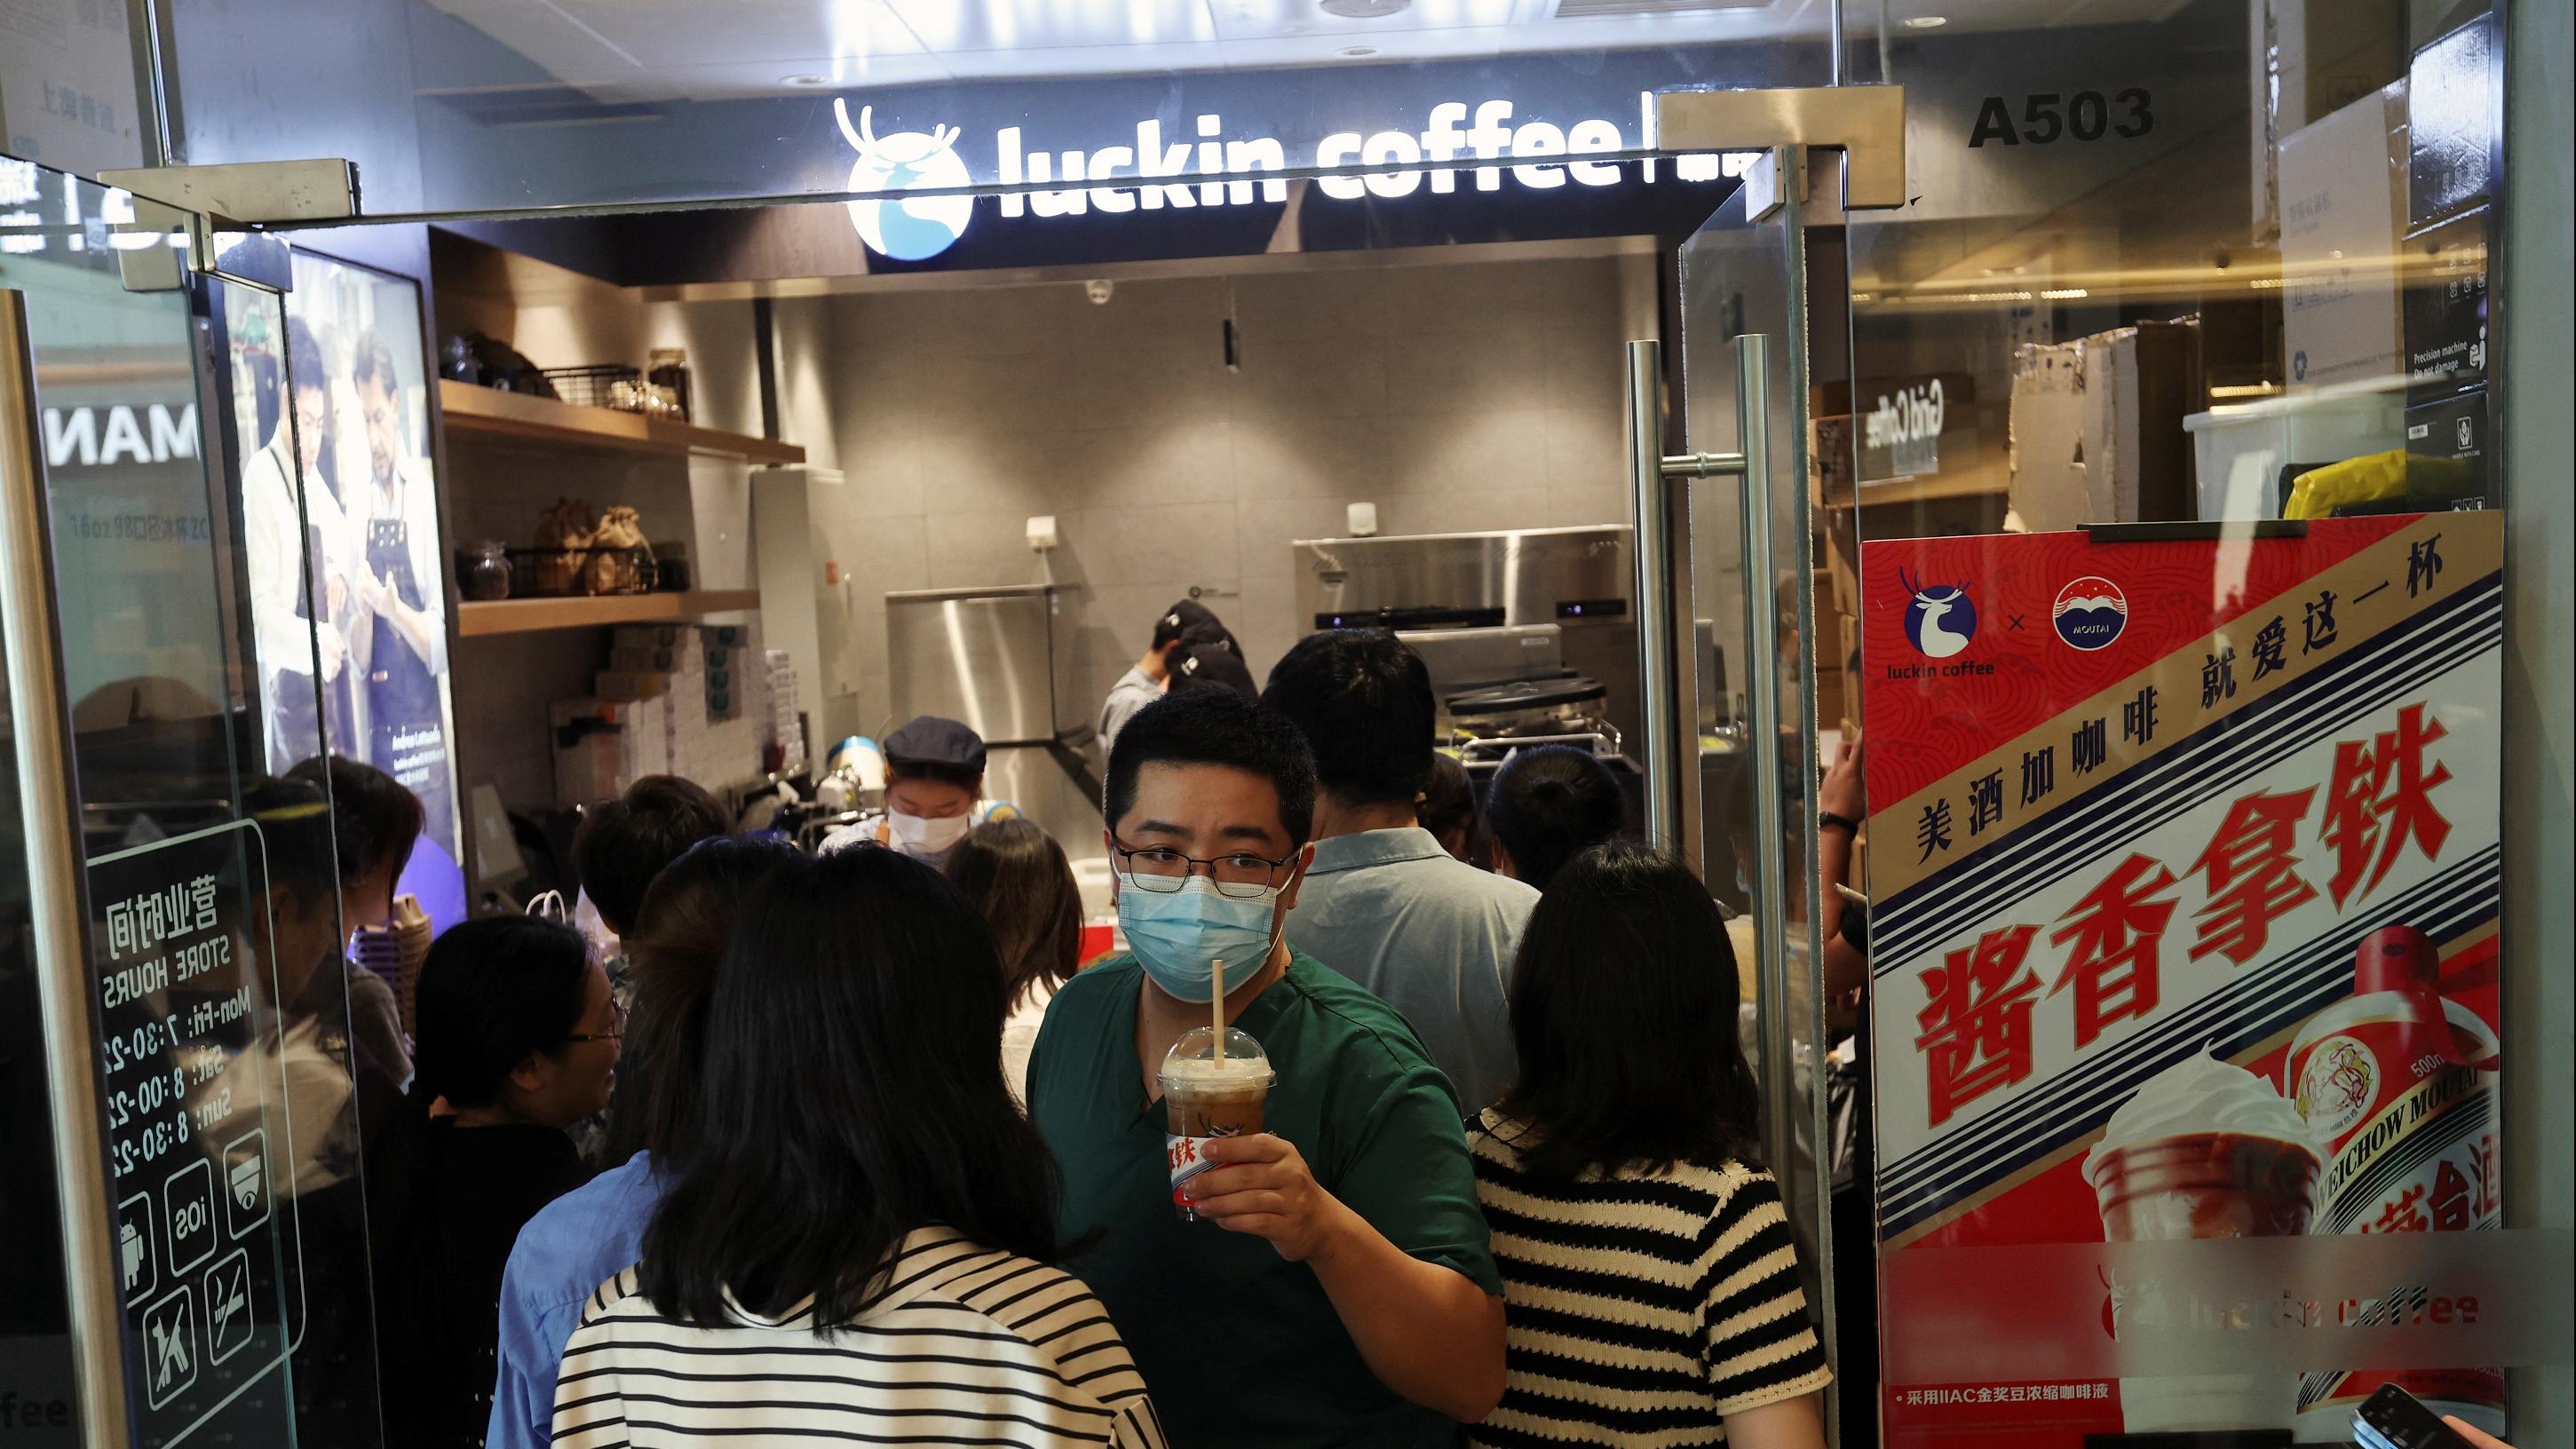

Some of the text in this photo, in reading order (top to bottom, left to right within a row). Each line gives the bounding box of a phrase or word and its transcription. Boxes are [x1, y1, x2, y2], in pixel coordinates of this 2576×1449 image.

[1969, 87, 2155, 148] A503
[997, 99, 1622, 218] luckin coffee
[2414, 348, 2440, 365] Precision
[2442, 340, 2468, 356] machine
[2414, 359, 2459, 380] Do not damage
[2073, 624, 2110, 635] MOUTAI
[1887, 660, 1994, 679] luckin coffee
[1917, 532, 2445, 865] 美酒加咖啡 就爱这一杯
[1914, 701, 2453, 1128] 酱香拿铁
[2338, 1286, 2479, 1326] coffee
[1906, 1383, 2109, 1405] 采用IIAC金奖豆浓缩咖啡液
